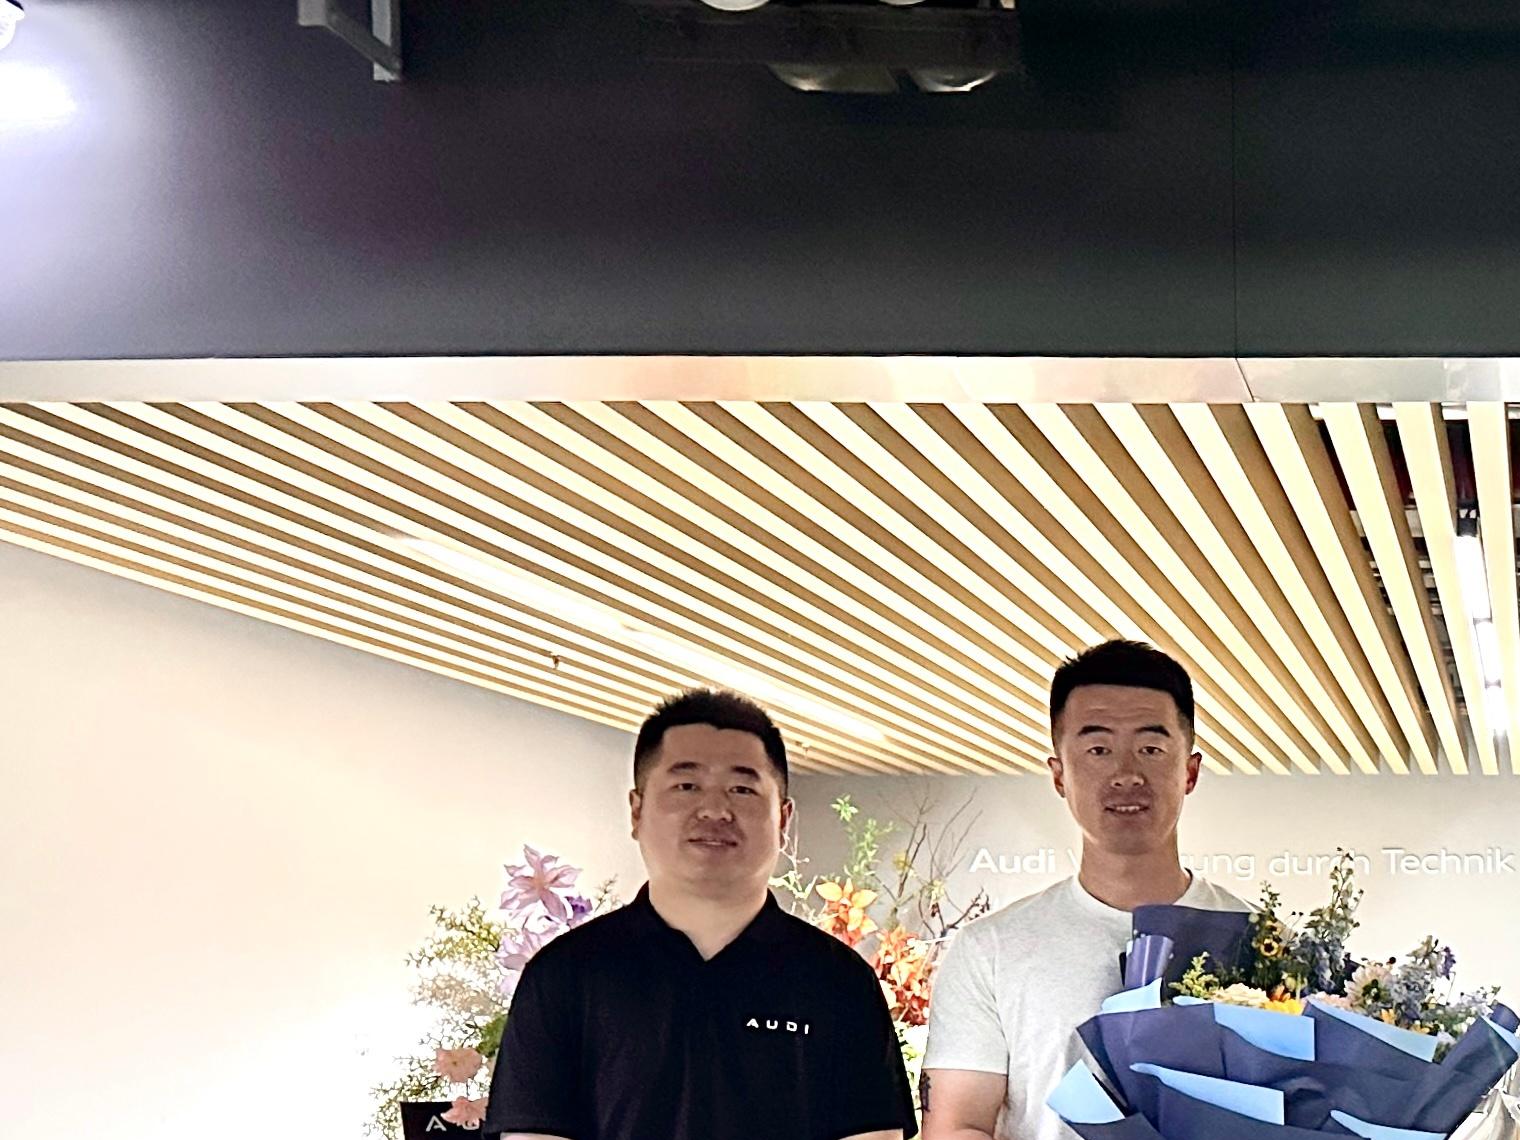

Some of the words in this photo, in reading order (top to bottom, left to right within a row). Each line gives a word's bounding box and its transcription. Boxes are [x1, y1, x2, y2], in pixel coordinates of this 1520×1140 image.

[969, 848, 1056, 874] Audi
[1381, 847, 1517, 875] Technik
[746, 1018, 810, 1035] AUDI
